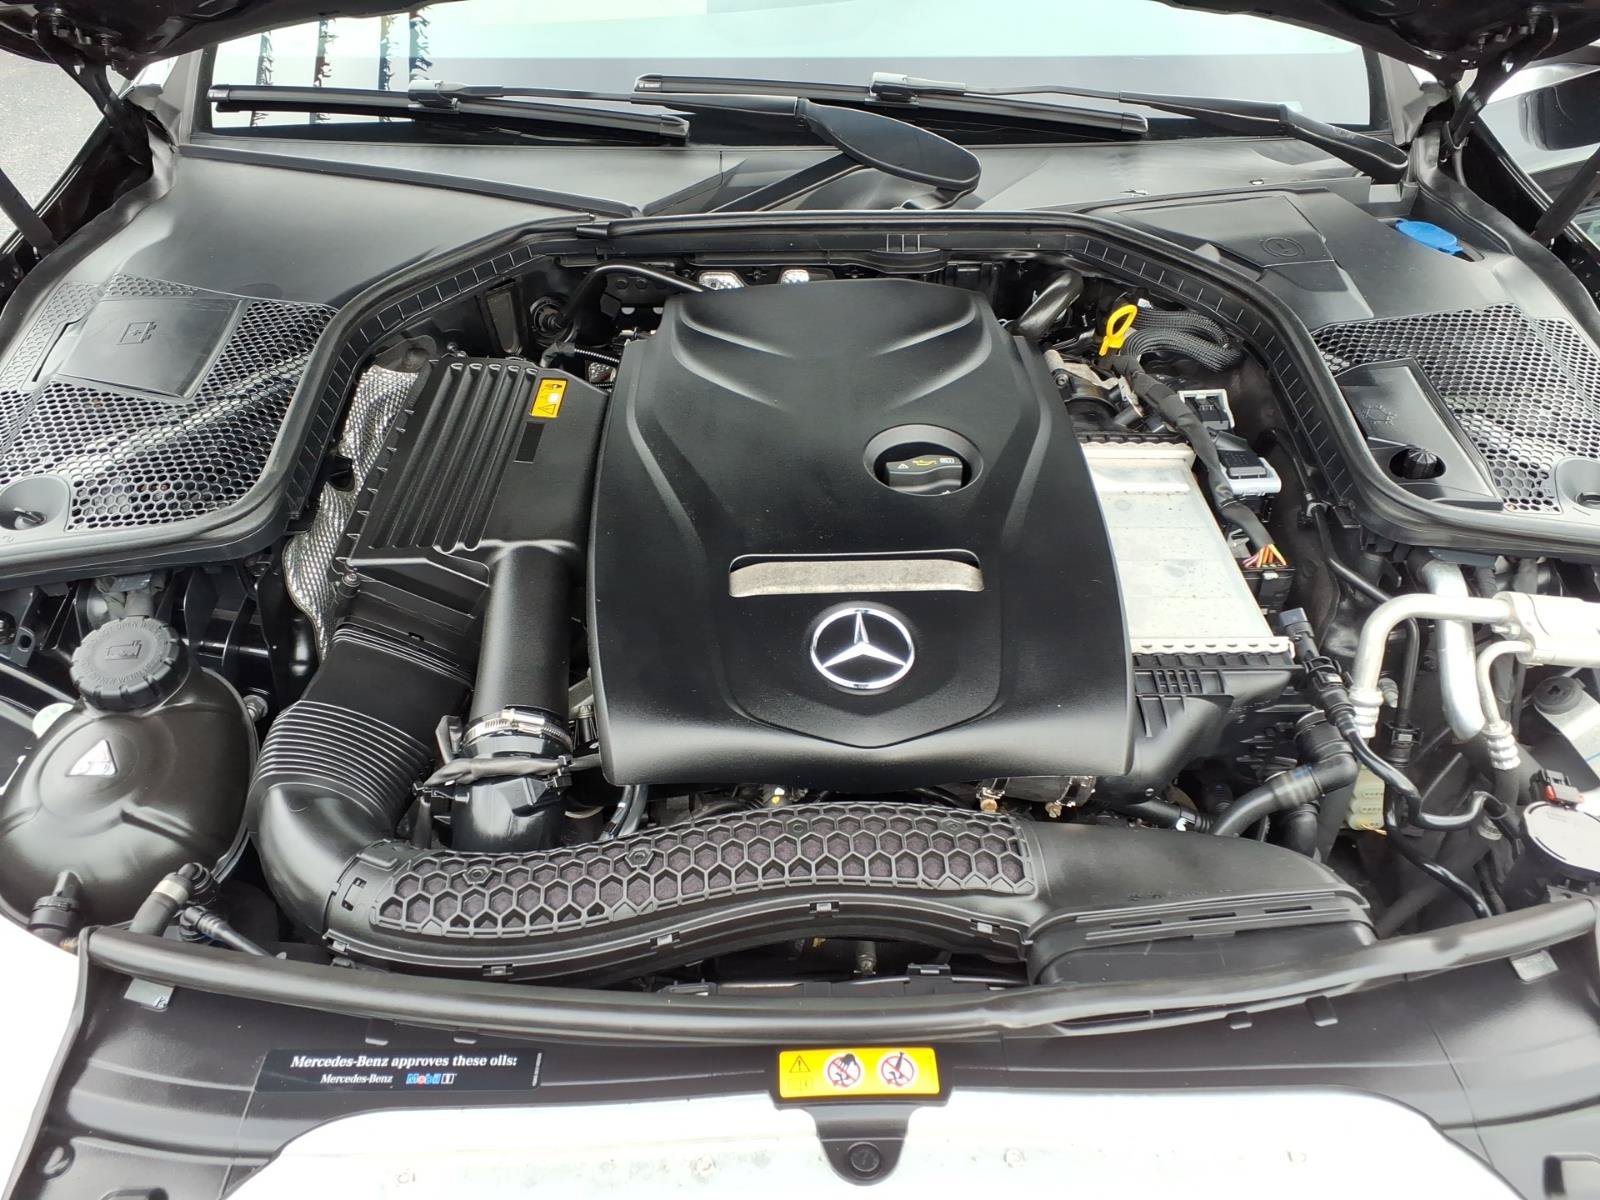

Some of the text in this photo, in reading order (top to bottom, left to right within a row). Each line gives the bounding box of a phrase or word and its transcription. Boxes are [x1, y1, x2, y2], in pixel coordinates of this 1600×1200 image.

[290, 1054, 518, 1069] Mercedes-Benz approves these oils:
[320, 1073, 393, 1084] Mercedes-Benz
